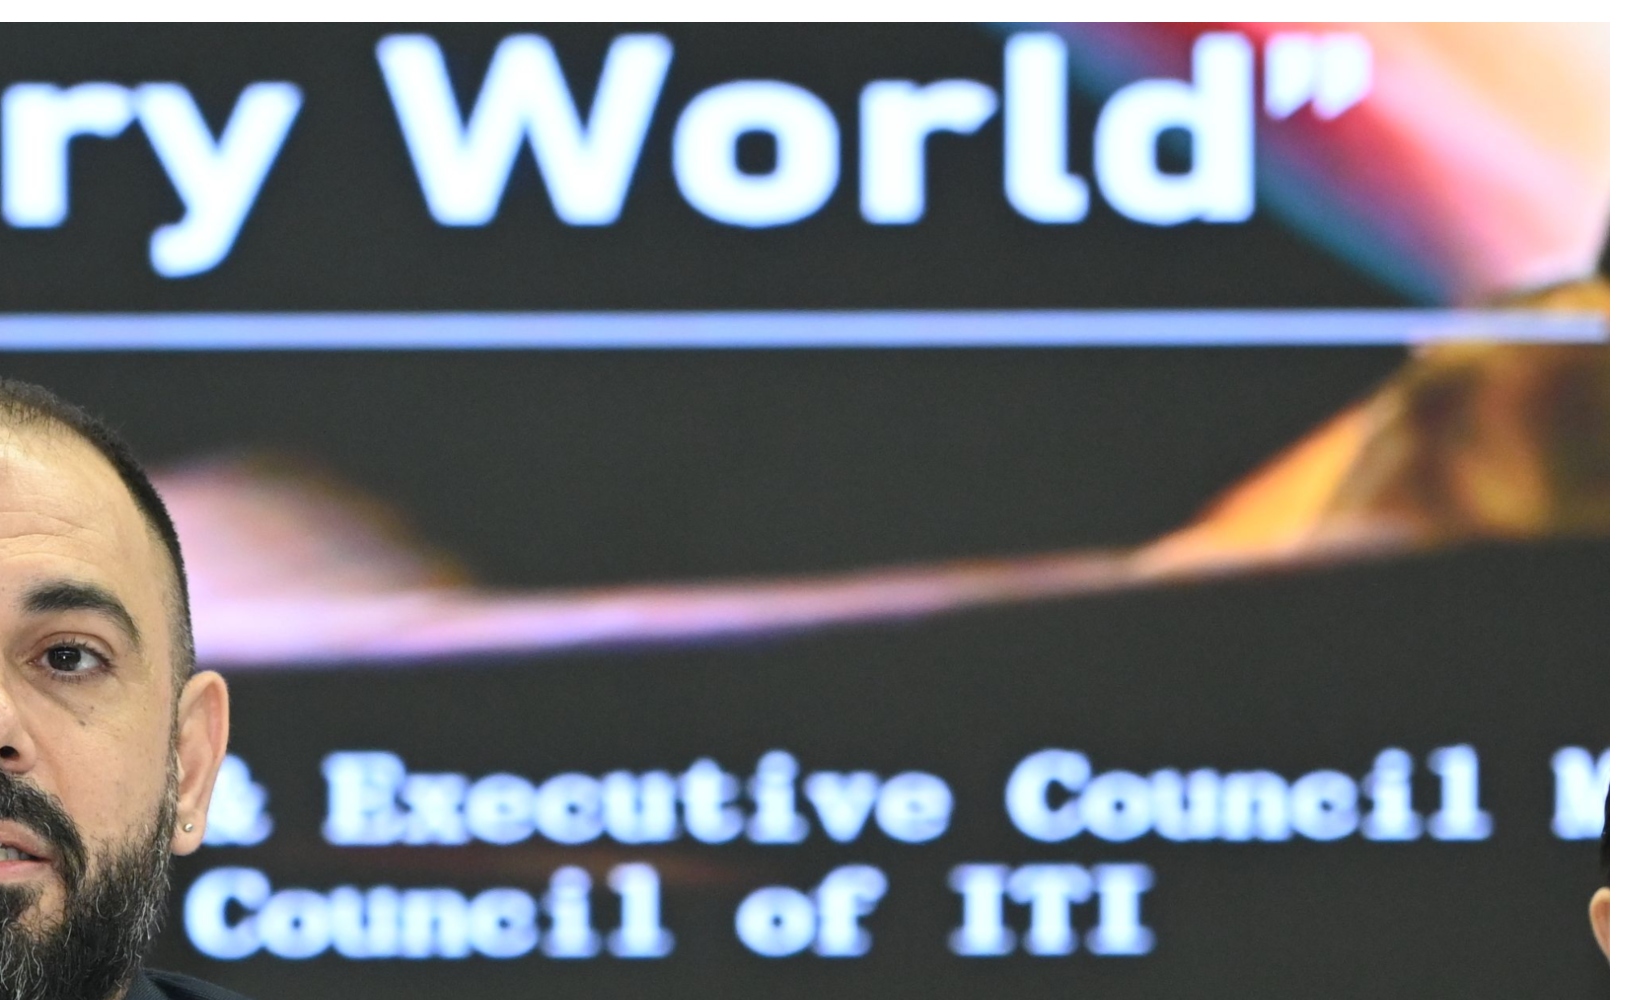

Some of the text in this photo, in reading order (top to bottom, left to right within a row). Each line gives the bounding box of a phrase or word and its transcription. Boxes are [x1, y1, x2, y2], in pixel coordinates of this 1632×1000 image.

[320, 750, 954, 846] Executive
[1004, 744, 1493, 842] Council
[183, 862, 675, 960] Council
[734, 863, 889, 958] of
[948, 862, 1156, 957] ITI
